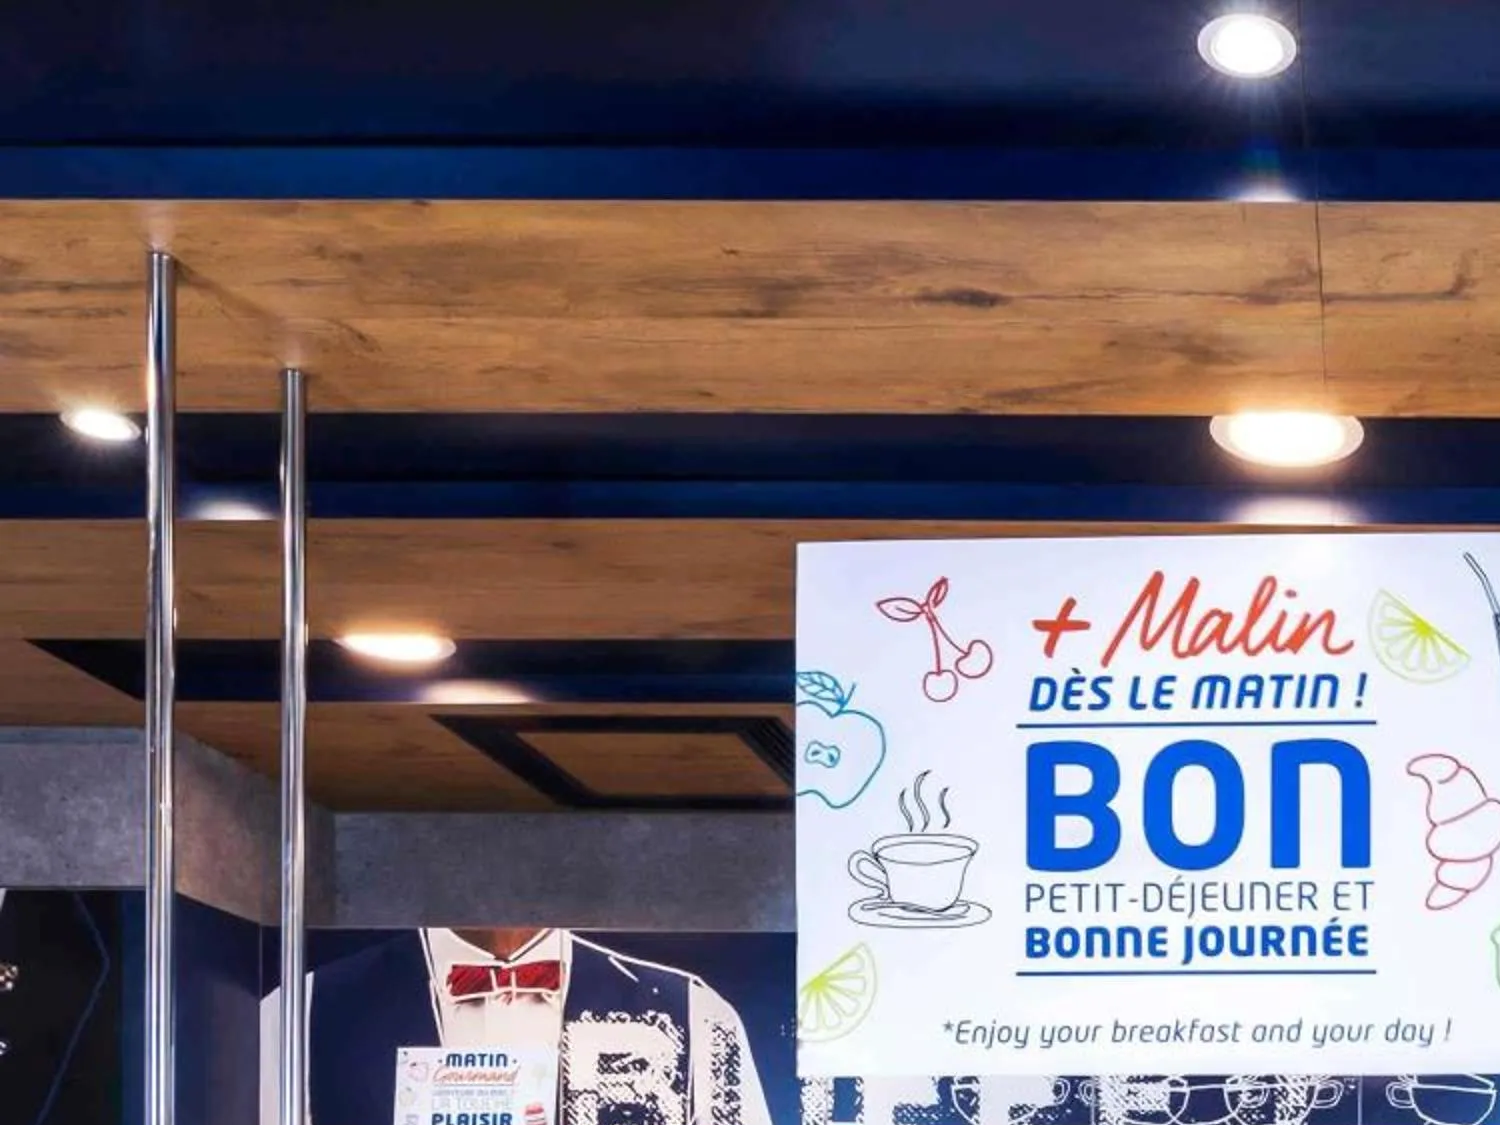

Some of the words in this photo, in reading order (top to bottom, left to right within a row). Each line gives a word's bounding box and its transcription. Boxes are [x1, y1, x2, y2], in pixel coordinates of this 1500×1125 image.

[1101, 571, 1354, 667] Malin
[1029, 667, 1112, 712] DÈS
[1128, 675, 1177, 710] LE
[1192, 673, 1340, 710] MATIN
[1355, 673, 1368, 709] !
[1025, 738, 1372, 873] BON
[1025, 876, 1318, 919] PETIT-DÉJEUNER
[1330, 880, 1374, 911] ET
[1025, 925, 1168, 959] BONNE
[1182, 920, 1369, 965] JOURNÉE
[1040, 1025, 1101, 1048] your
[1111, 1019, 1241, 1043] breakfast
[1252, 1019, 1303, 1043] and
[1312, 1024, 1372, 1048] your
[1384, 1018, 1434, 1046] day
[1445, 1018, 1452, 1038] !
[445, 1053, 509, 1068] MATIN
